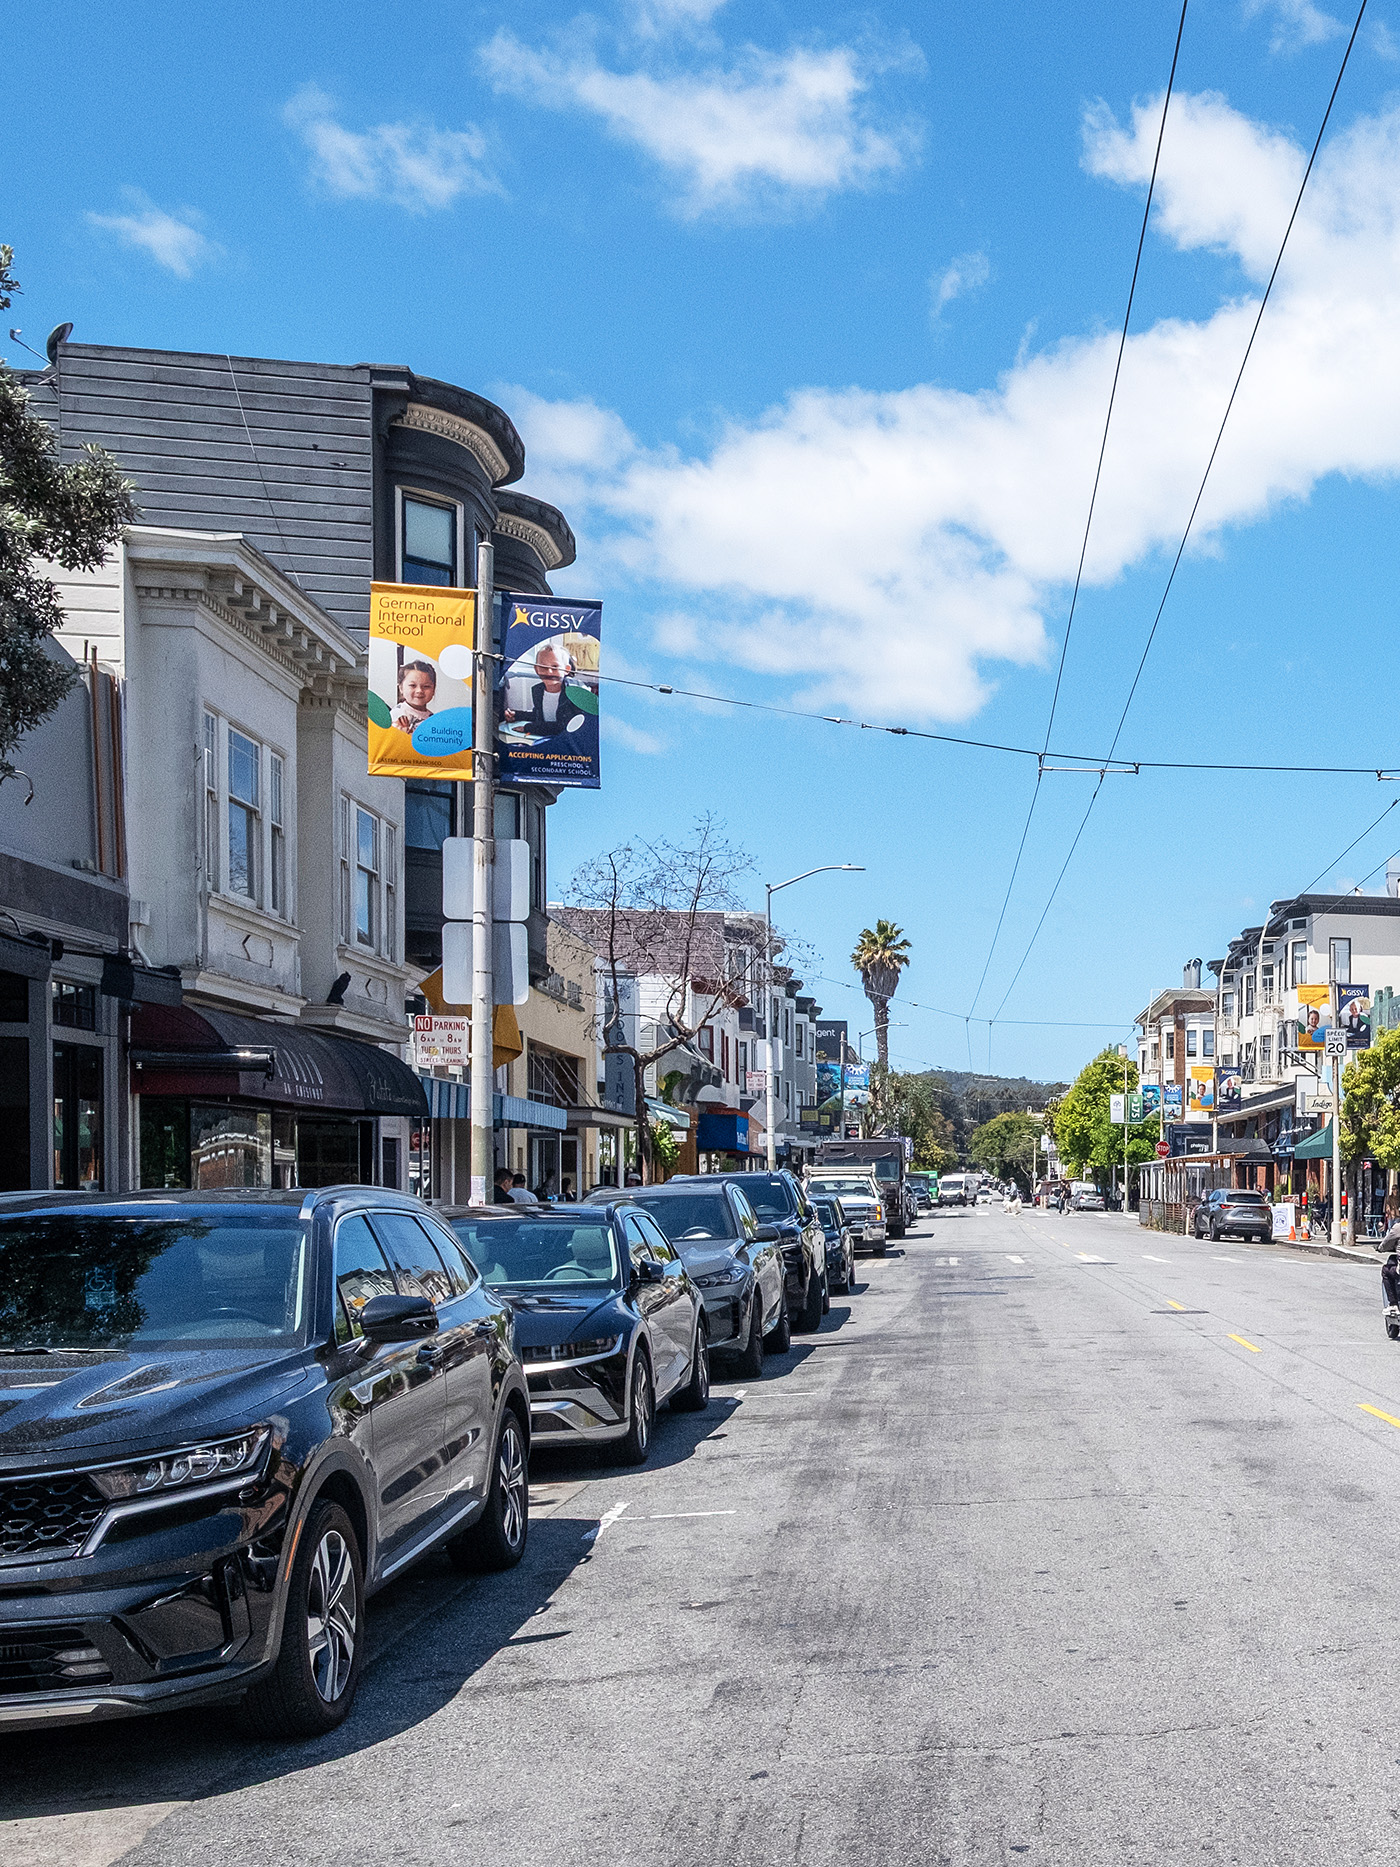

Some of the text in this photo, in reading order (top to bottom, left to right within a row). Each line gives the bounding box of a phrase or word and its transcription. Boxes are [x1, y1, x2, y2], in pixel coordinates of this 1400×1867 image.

[379, 597, 434, 611] German
[378, 610, 466, 626] International
[530, 612, 584, 629] GISSV
[378, 622, 424, 636] School
[431, 727, 463, 738] Building
[417, 735, 464, 746] Community
[508, 752, 592, 762] ACCEPTING APPLICATIONS
[550, 761, 584, 769] PRESCHOOL
[417, 1018, 466, 1031] NO PARKING
[442, 1046, 462, 1055] THURS
[1327, 1043, 1344, 1054] 20
[1312, 1099, 1333, 1109] Indigo
